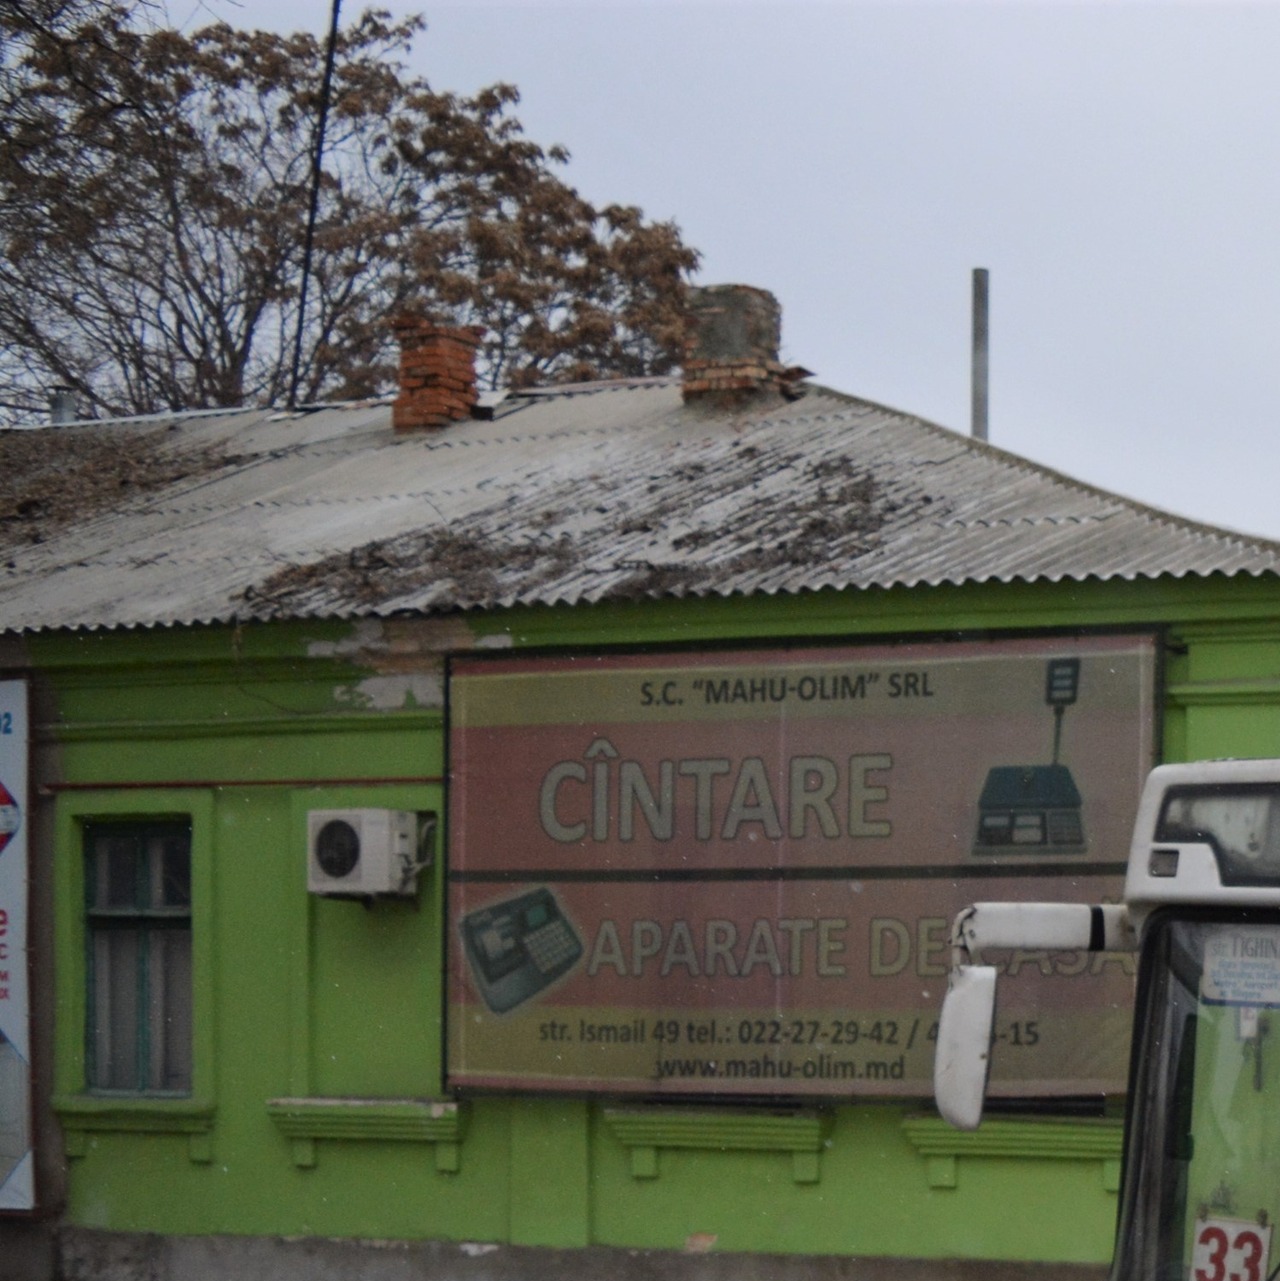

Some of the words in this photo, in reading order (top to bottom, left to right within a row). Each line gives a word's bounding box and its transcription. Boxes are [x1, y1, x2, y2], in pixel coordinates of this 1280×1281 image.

[640, 680, 684, 706] S.C.
[888, 672, 934, 698] SRL
[537, 737, 894, 844] CÎNTARE
[586, 918, 847, 978] APARATE
[869, 915, 948, 978] DE
[539, 1020, 573, 1043] str.
[578, 1018, 647, 1044] Ismail
[652, 1021, 680, 1044] 49
[686, 1020, 731, 1045] tel.:
[737, 1020, 899, 1046] 022-27-29-42
[656, 1054, 905, 1081] www.mahu-olim.md
